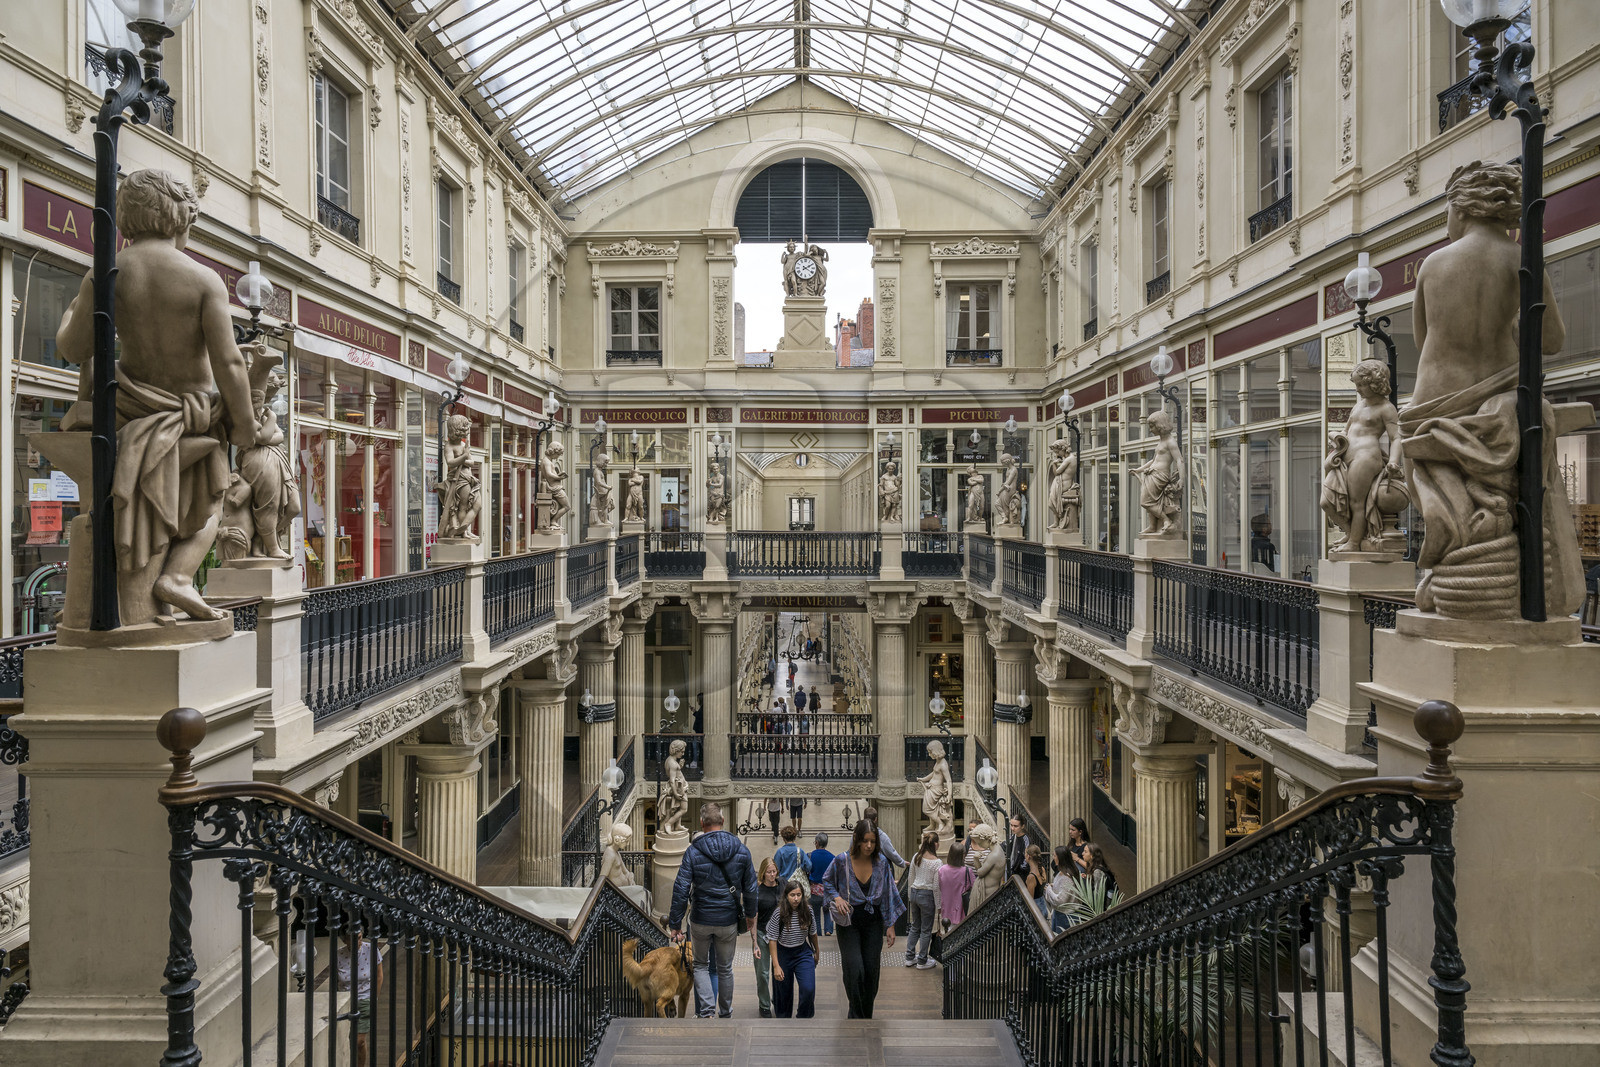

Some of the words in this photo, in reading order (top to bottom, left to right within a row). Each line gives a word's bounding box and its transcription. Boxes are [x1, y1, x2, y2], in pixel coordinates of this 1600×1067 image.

[46, 201, 79, 239] LA
[318, 311, 351, 338] ALICE
[353, 324, 387, 352] DELICE
[582, 411, 632, 421] ATELIER
[634, 411, 686, 422] COQLICO
[742, 410, 789, 421] GALERIE
[791, 411, 804, 421] DE
[807, 410, 867, 422] L'HORLOGE
[949, 410, 1001, 421] PICTURE
[763, 595, 847, 606] PARFUMERIE
